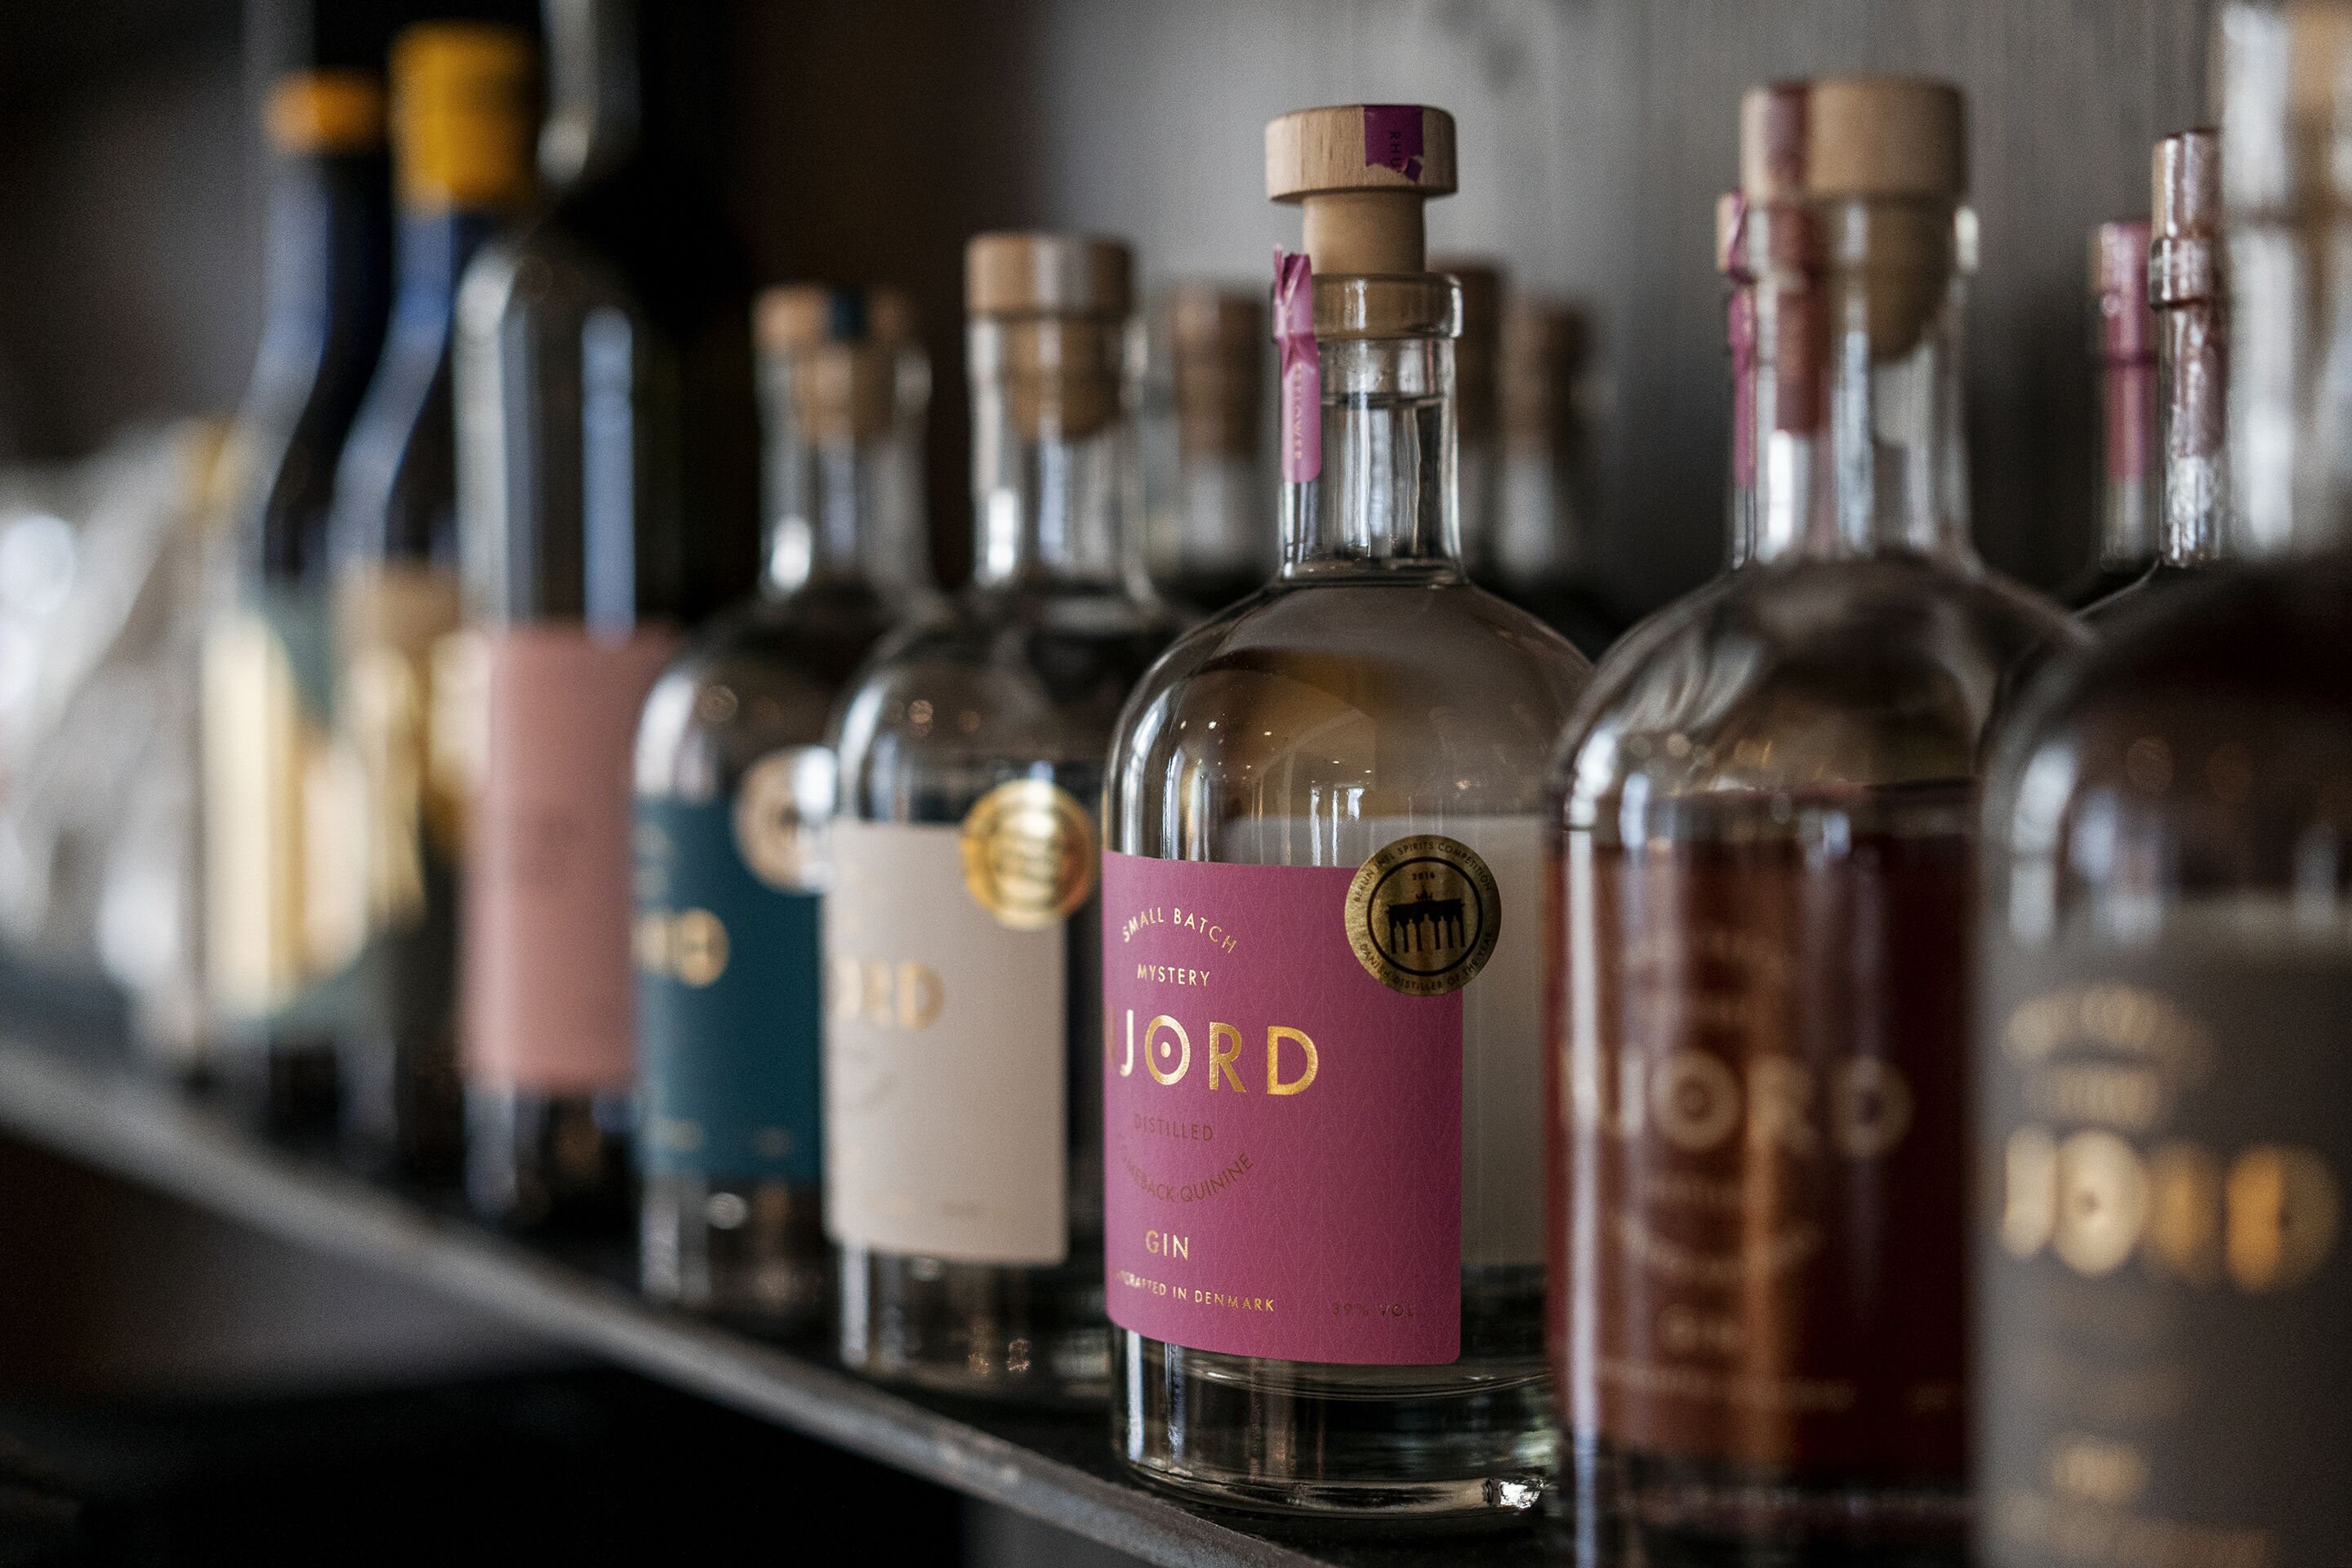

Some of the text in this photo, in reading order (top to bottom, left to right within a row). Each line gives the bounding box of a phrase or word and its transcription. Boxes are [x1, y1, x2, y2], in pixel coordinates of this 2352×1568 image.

[1397, 841, 1434, 855] SPIRITS
[1438, 842, 1492, 891] COMPETITION
[1122, 906, 1236, 953] SMALL BATCH
[1137, 964, 1210, 987] MYSTERY
[1134, 1114, 1214, 1142] DISTILLED
[1179, 1152, 1254, 1203] QUININE
[1146, 1229, 1189, 1261] GIN
[1172, 1285, 1187, 1300] IN
[1194, 1290, 1275, 1312] DENMARK
